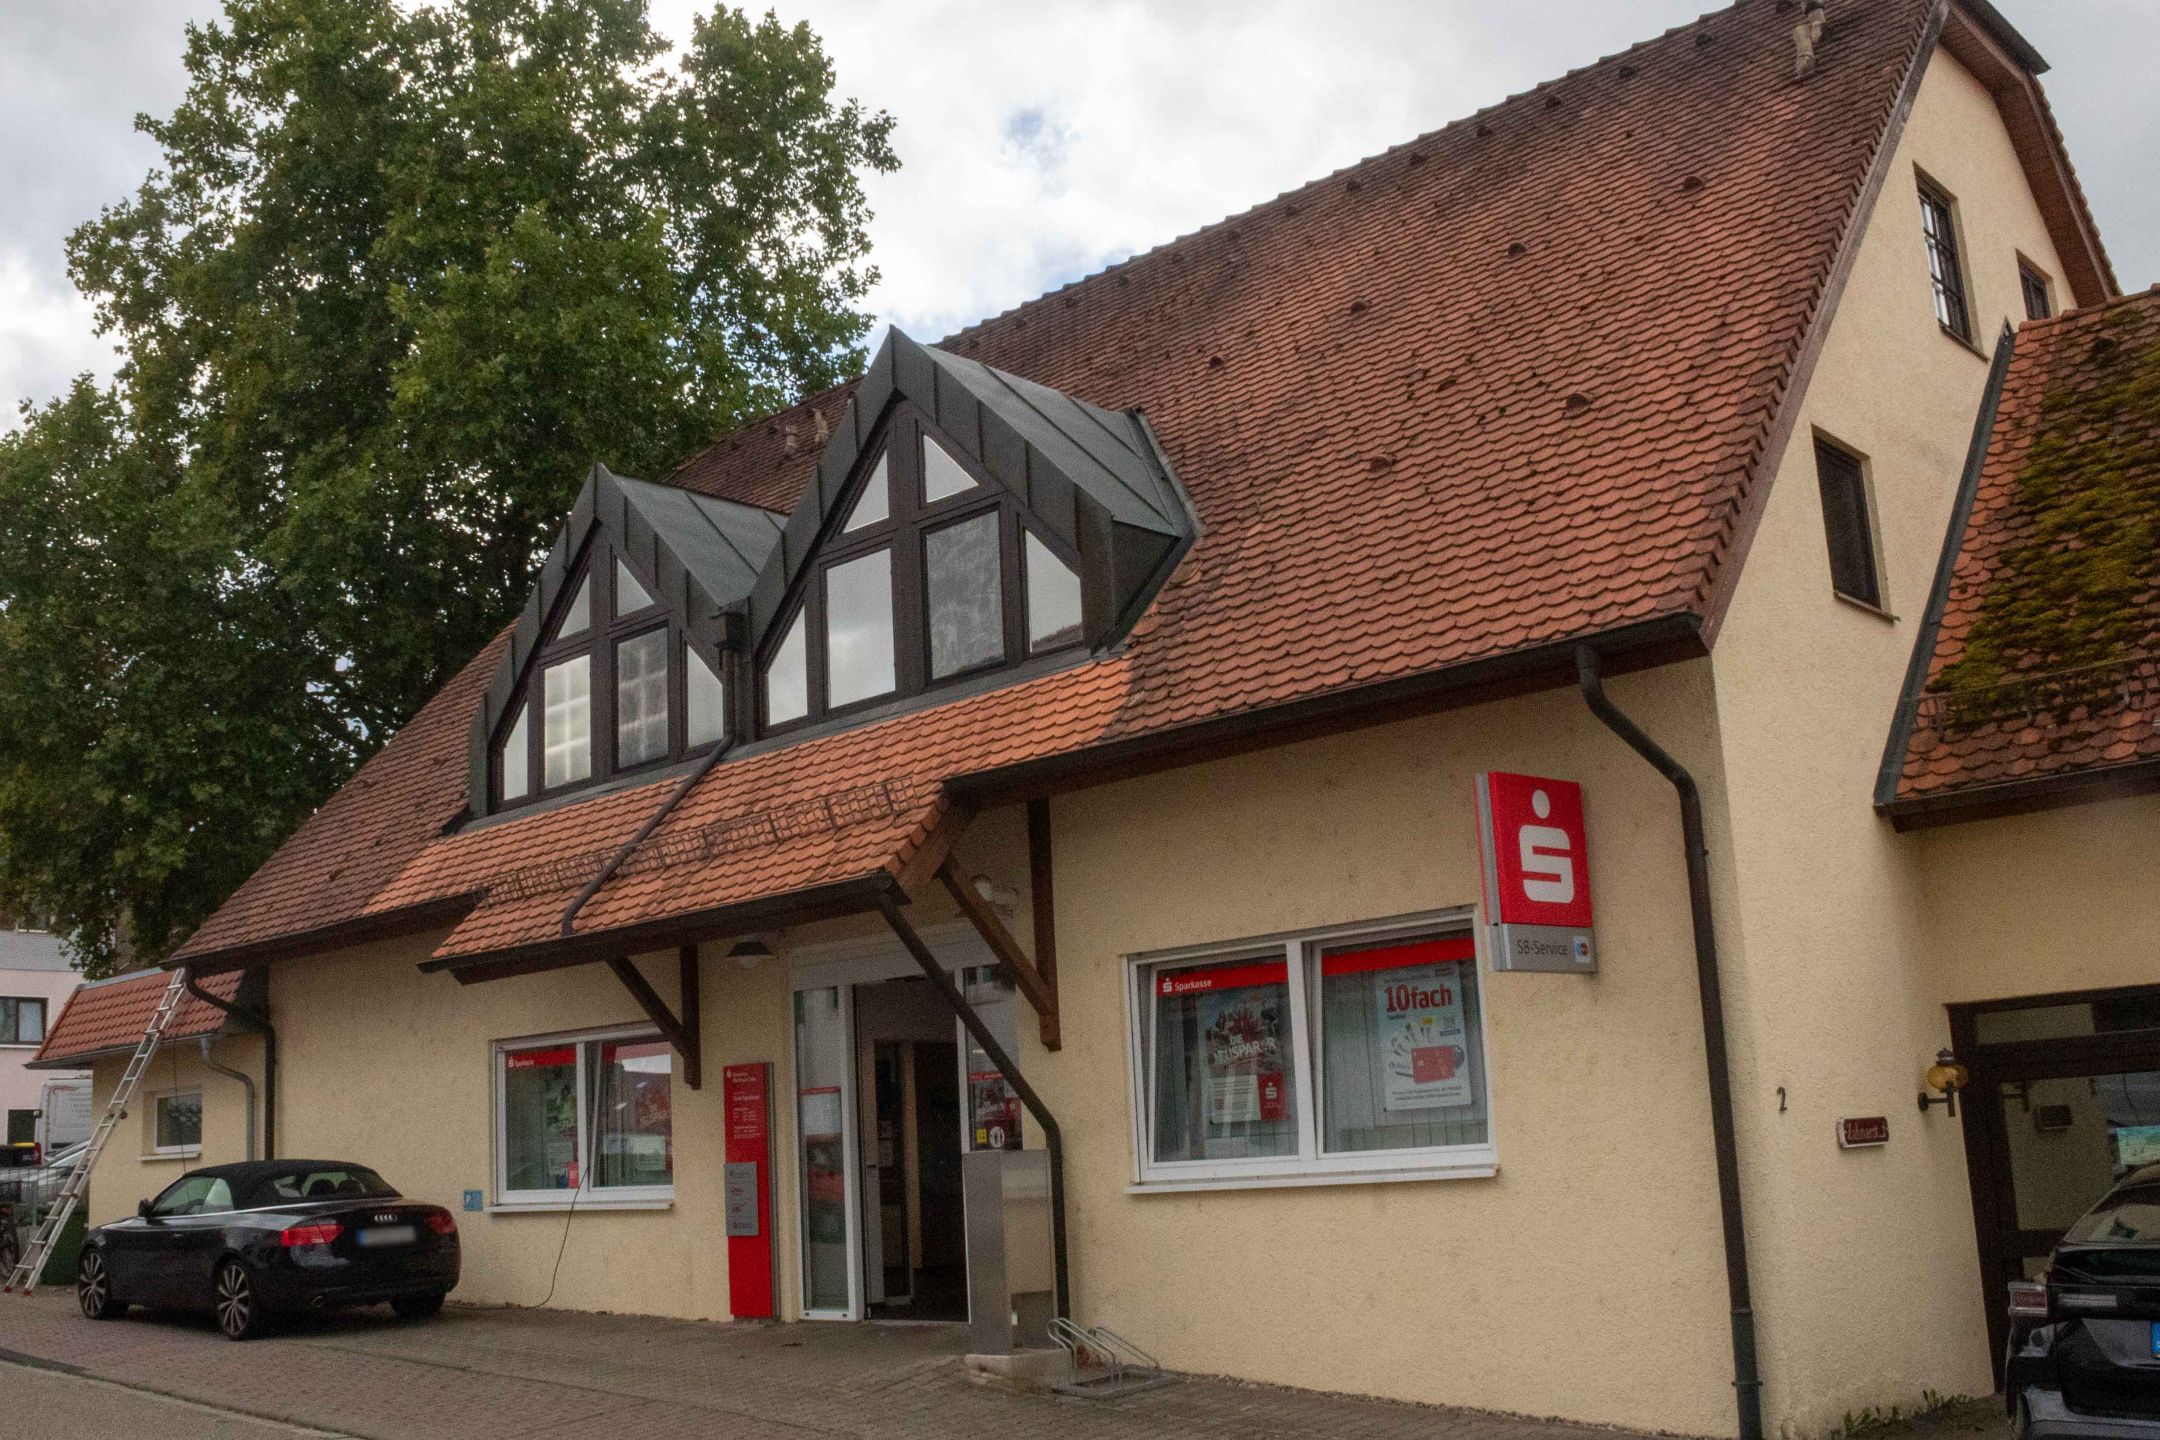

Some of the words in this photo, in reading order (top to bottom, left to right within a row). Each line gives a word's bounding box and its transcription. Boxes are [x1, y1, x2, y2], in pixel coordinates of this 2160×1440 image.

[1516, 939, 1568, 956] SB-Service
[1174, 979, 1212, 992] Sparkasse
[1383, 983, 1453, 1013] 10fach
